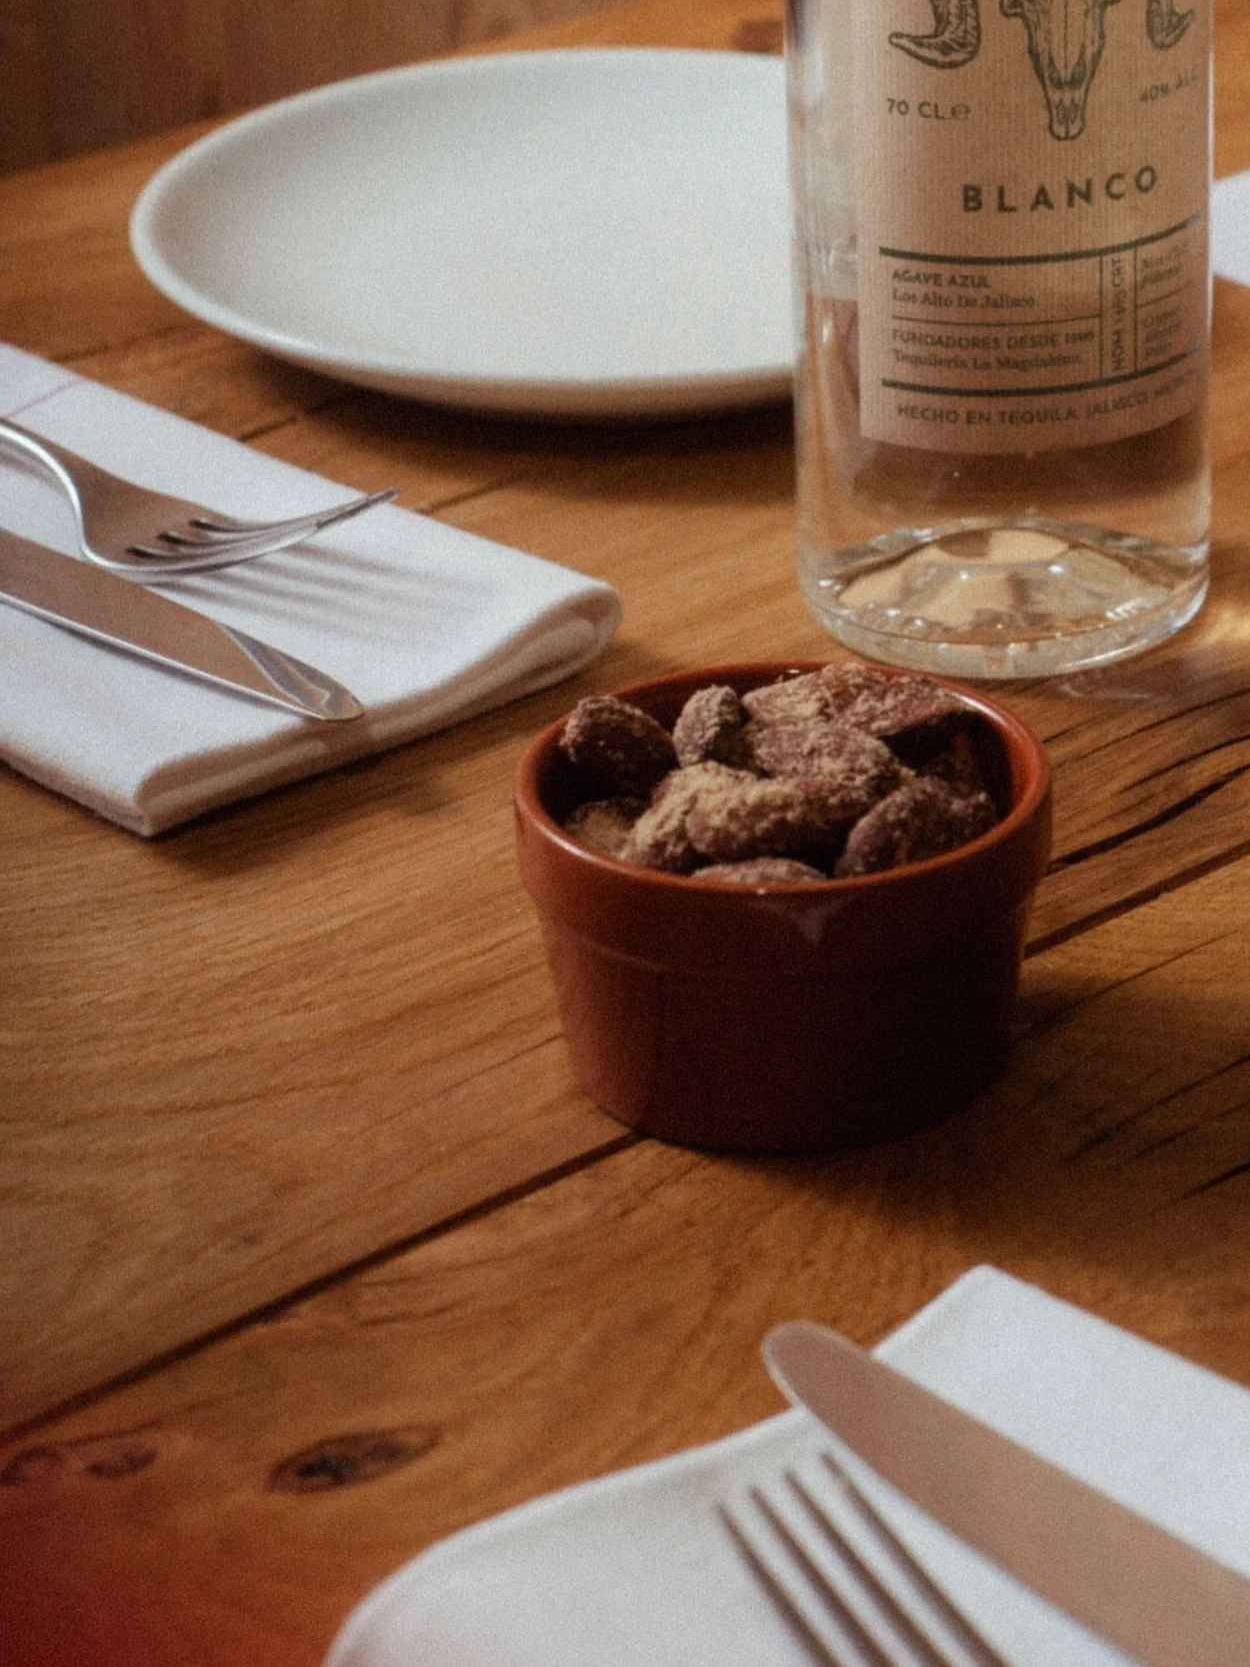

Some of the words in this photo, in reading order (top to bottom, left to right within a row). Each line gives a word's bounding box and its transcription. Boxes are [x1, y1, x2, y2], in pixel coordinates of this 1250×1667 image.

[886, 96, 910, 116] 70
[962, 165, 1159, 213] BLANCO
[891, 269, 942, 287] AGAVE
[948, 273, 991, 289] AZUL
[891, 329, 1001, 350] FUNDADORES
[1006, 332, 1059, 350] DESDE
[896, 403, 959, 424] HECHO
[965, 409, 992, 425] EN
